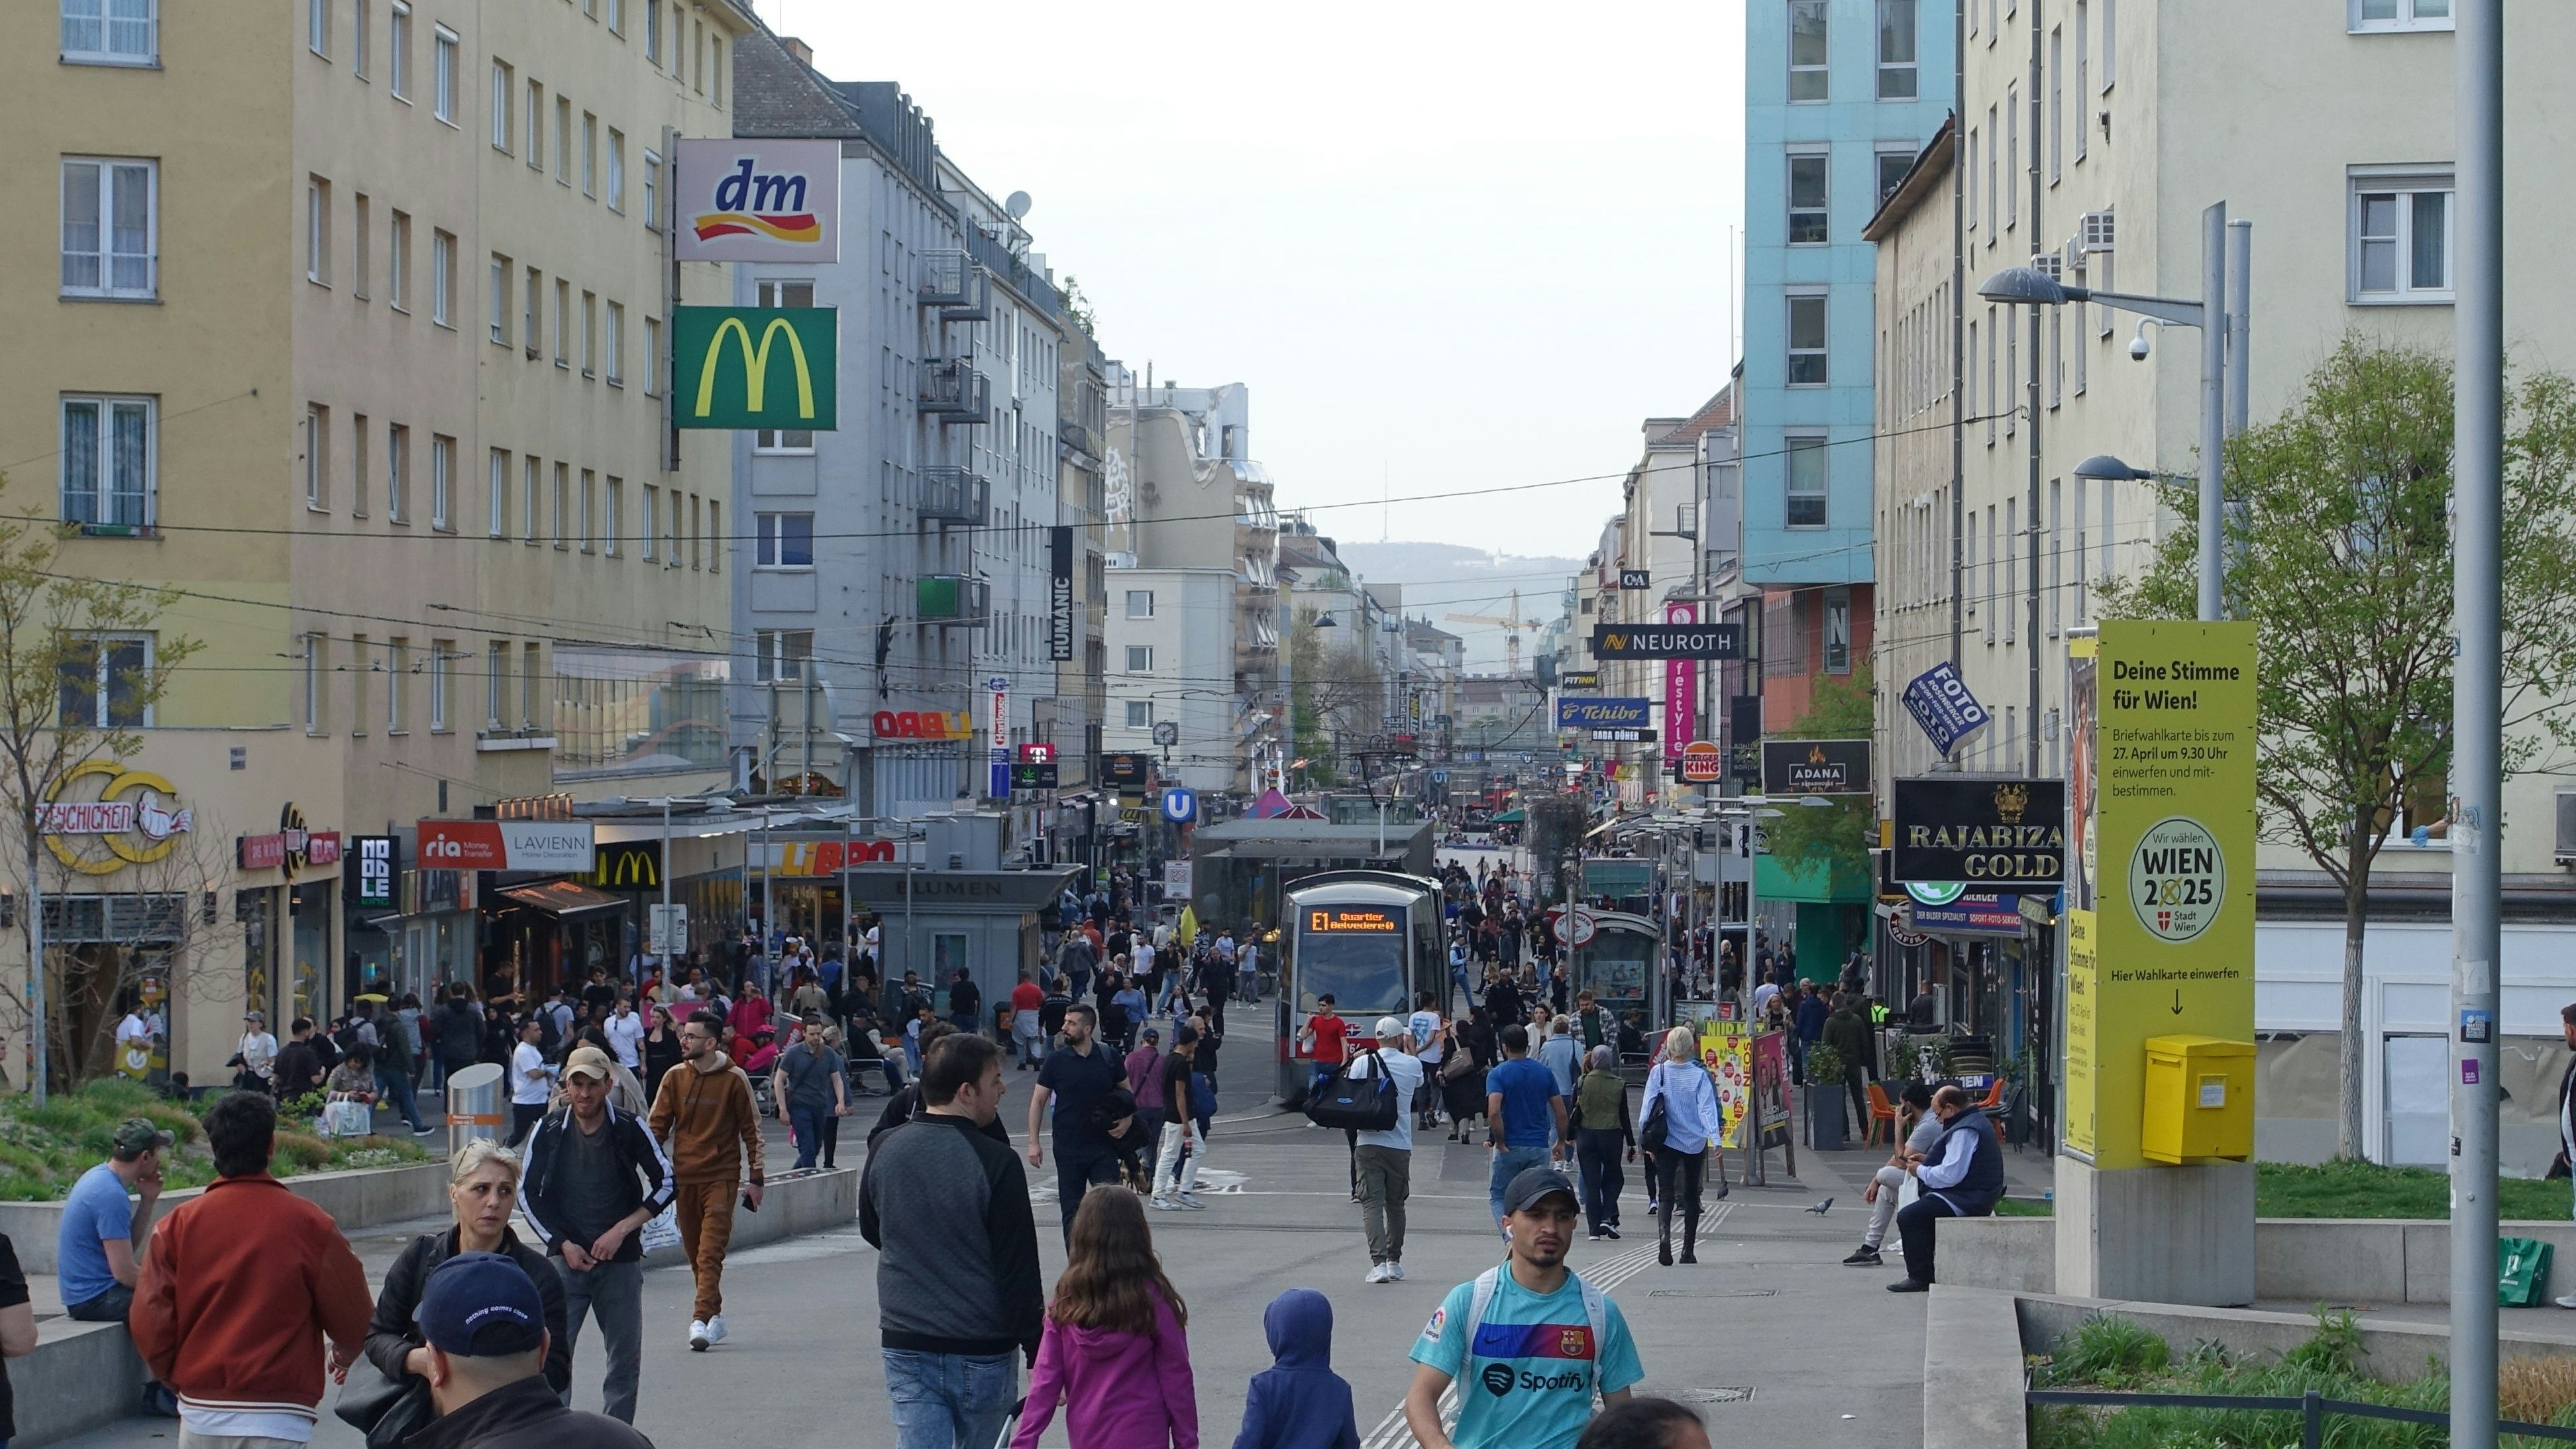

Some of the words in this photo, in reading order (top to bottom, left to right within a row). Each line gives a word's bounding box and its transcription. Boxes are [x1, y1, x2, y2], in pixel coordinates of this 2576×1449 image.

[716, 159, 806, 211] dm
[1624, 574, 1645, 586] C&A
[1054, 577, 1069, 659] HUMANIC
[1633, 634, 1730, 650] NEUROTH
[2114, 661, 2166, 680] Deine
[2171, 661, 2239, 680] Stimme
[1928, 680, 1964, 725] ROSENBERGER
[1934, 667, 1981, 722] FOTO
[2113, 690, 2140, 709] für
[2145, 690, 2197, 709] Wien!
[1582, 706, 1642, 720] Tchibo
[1909, 687, 1949, 742] FOTO
[1593, 731, 1612, 740] BABA
[1615, 729, 1638, 741] DÖNER
[2113, 729, 2191, 741] Briefwahlkarte
[2194, 729, 2210, 741] bis
[2213, 731, 2234, 741] zum
[2113, 749, 2127, 760] 27.
[2131, 747, 2158, 763] April
[2161, 751, 2177, 759] um
[2180, 748, 2204, 759] 9.30
[2208, 748, 2227, 759] Uhr
[1686, 763, 1719, 773] KING
[1795, 769, 1840, 778] ADANA
[2113, 766, 2167, 778] einwerfen
[2170, 766, 2190, 778] und
[2193, 766, 2215, 778] mit-
[2113, 784, 2176, 796] bestimmen.
[1168, 795, 1190, 818] U
[426, 833, 460, 858] ria
[515, 837, 585, 850] LAVIENN
[1908, 825, 2065, 851] RAJABIZA
[2153, 833, 2169, 843] Wir
[2171, 832, 2203, 843] wählen
[464, 842, 490, 851] Money
[1964, 854, 2059, 877] GOLD
[2142, 848, 2212, 875] WIEN
[896, 881, 1001, 894] BLUMEN
[1313, 913, 1328, 930] E1
[1927, 912, 1941, 920] BILDER
[1942, 912, 1966, 922] SPEZIALIST
[2174, 910, 2196, 922] Stadt
[1891, 920, 1922, 944] TRAFIK
[2071, 918, 2085, 939] Deine
[2174, 922, 2196, 933] Wien
[2070, 945, 2088, 969] Stimme
[2112, 970, 2133, 982] Hier
[2135, 969, 2187, 981] Wahlkarte
[2190, 967, 2239, 980] einwerfen
[1780, 1036, 1789, 1081] NEOS
[465, 1307, 488, 1324] nothing
[1520, 1371, 1585, 1392] Spotify
